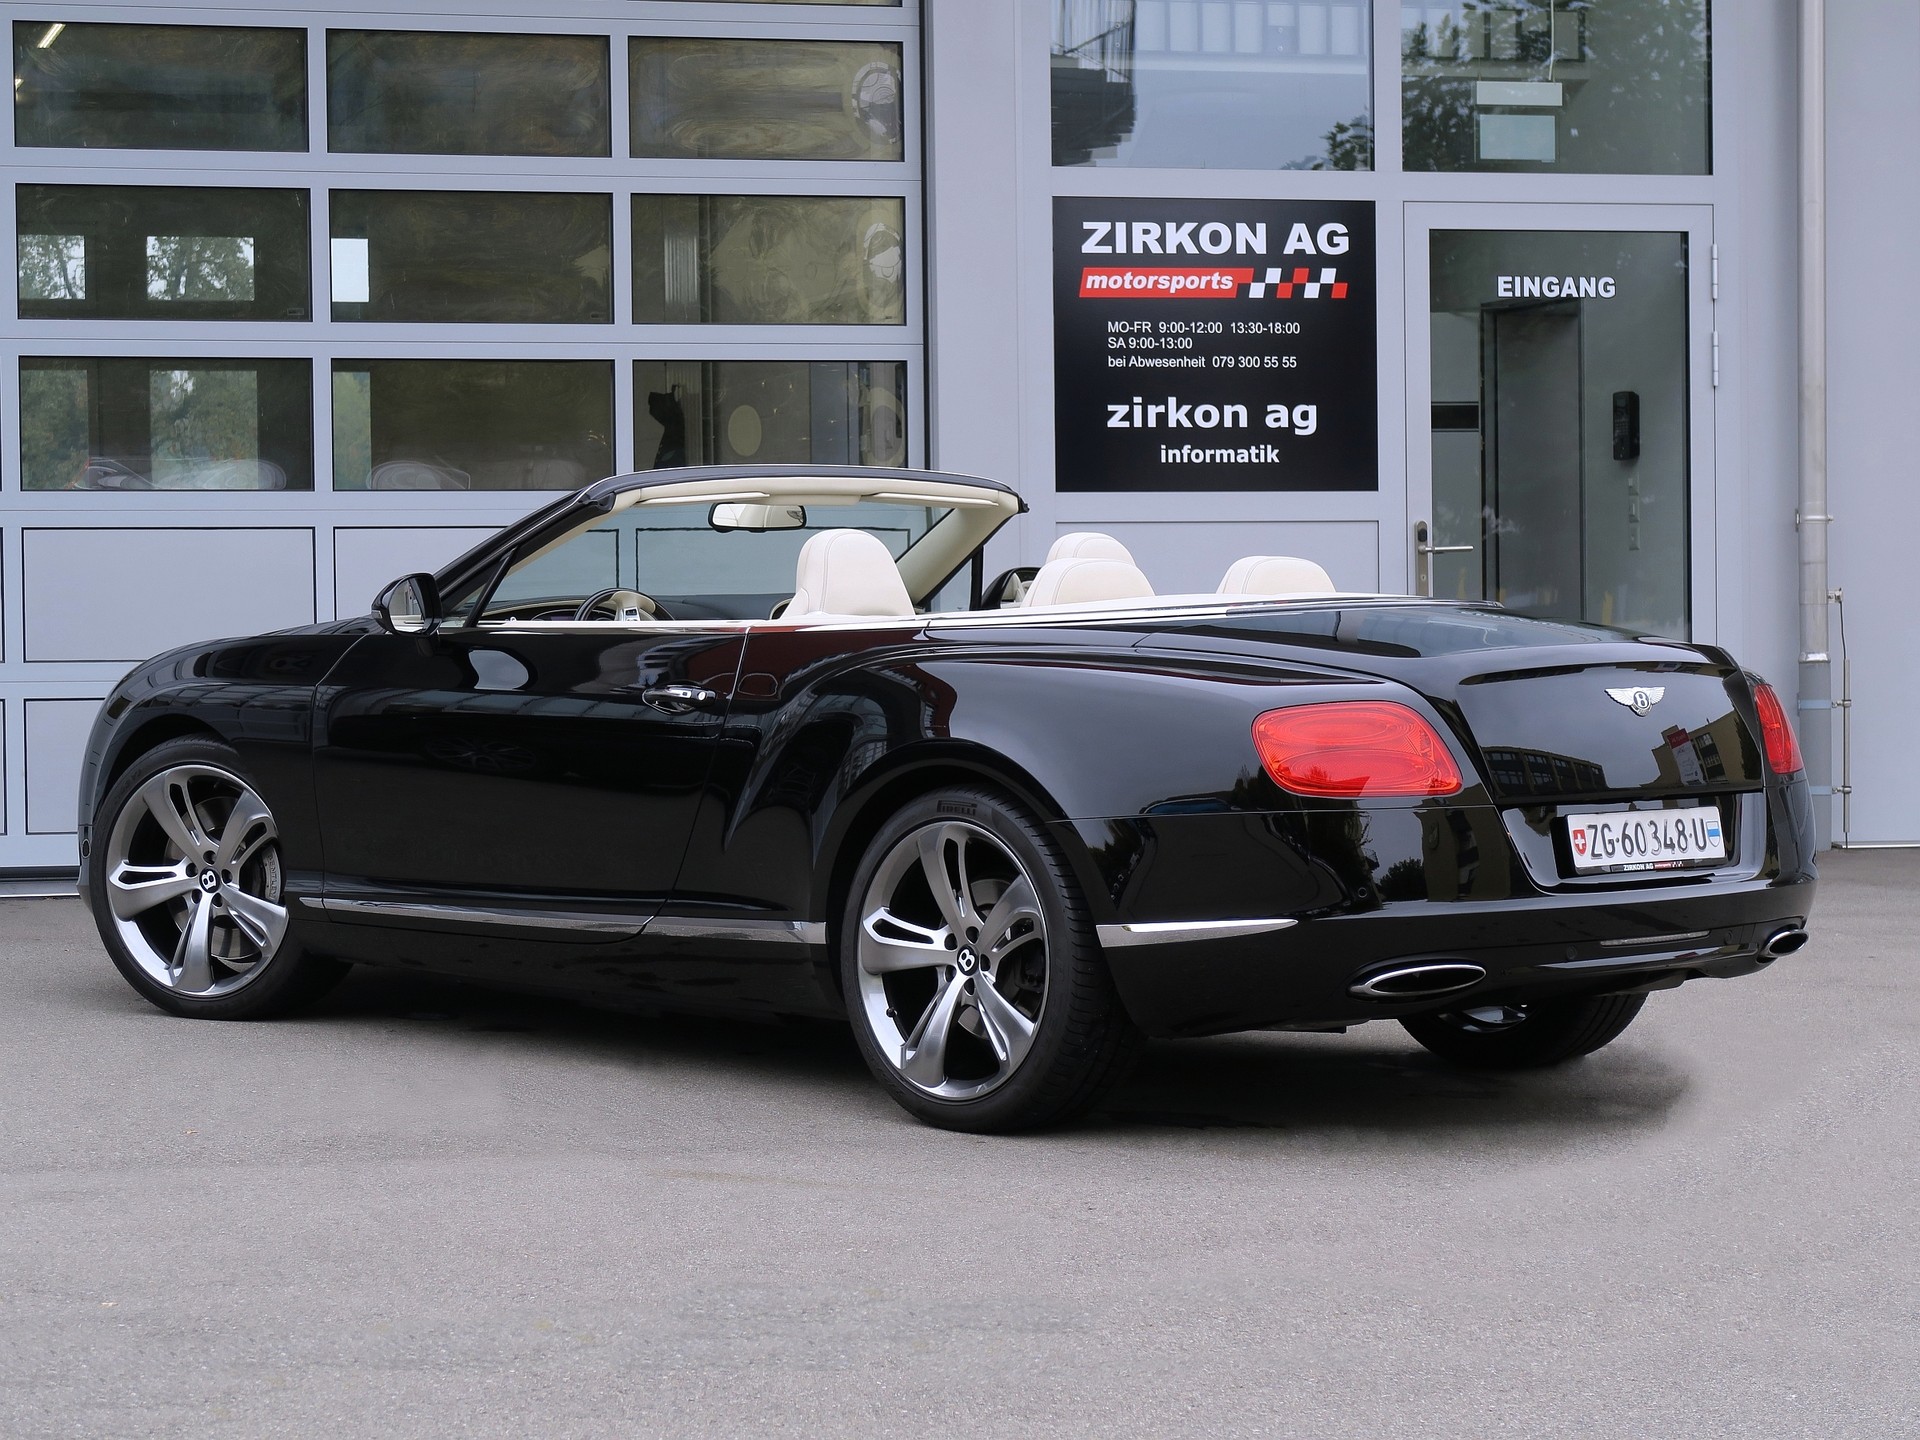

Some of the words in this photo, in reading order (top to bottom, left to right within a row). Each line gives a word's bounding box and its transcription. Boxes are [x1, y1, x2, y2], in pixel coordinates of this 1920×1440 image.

[1081, 221, 1267, 255] ZIRKON
[1283, 222, 1350, 255] AG
[1085, 271, 1234, 294] motorsports
[1497, 276, 1616, 298] EINGANG
[1107, 321, 1152, 334] MO-FR
[1158, 321, 1223, 334] 9:00-12:00
[1230, 321, 1301, 335] 13:30-18:00
[1107, 337, 1127, 349] SA
[1128, 337, 1193, 350] 9:00-13:00
[1107, 356, 1127, 368] bei
[1128, 356, 1206, 368] Abwesenheit
[1212, 356, 1235, 368] 079
[1237, 356, 1261, 368] 300
[1263, 356, 1279, 368] 55
[1281, 356, 1297, 369] 55
[1106, 396, 1248, 429] zirkon
[1264, 404, 1317, 436] ag
[1160, 444, 1280, 464] informatik
[937, 800, 977, 816] PIRELLI
[1646, 862, 1654, 870] AG
